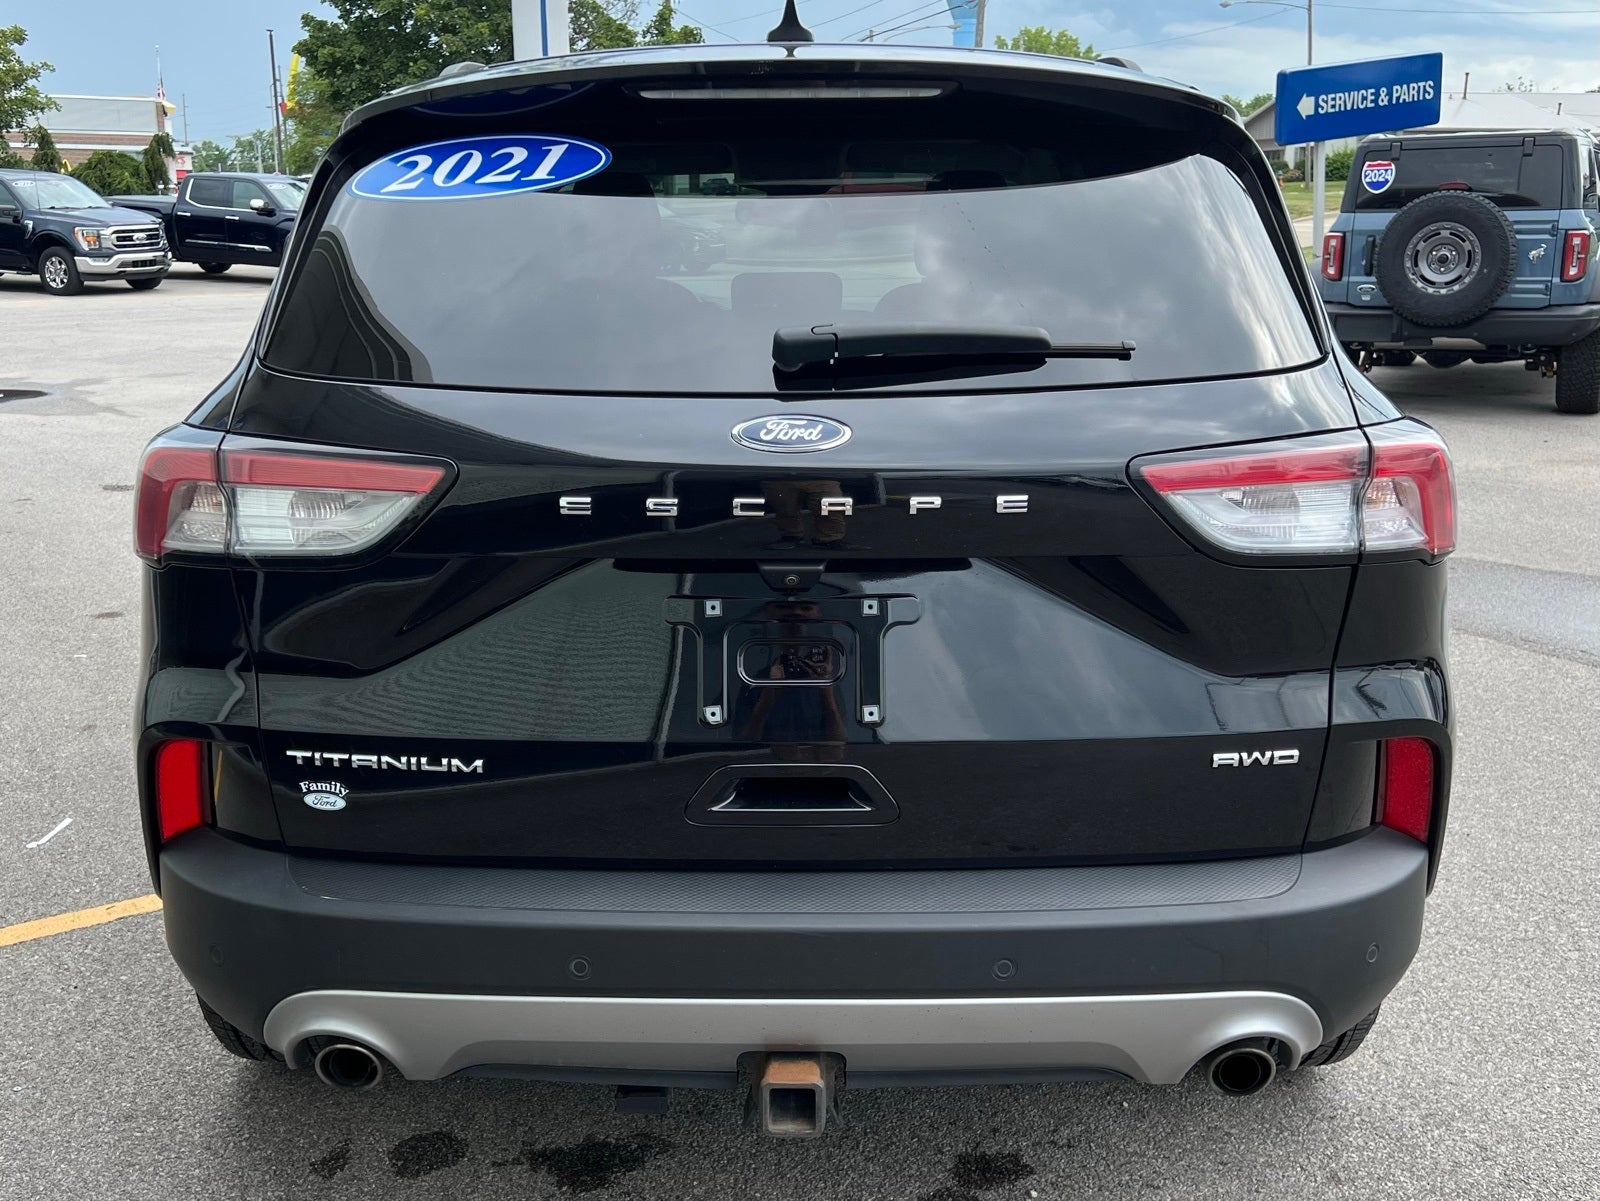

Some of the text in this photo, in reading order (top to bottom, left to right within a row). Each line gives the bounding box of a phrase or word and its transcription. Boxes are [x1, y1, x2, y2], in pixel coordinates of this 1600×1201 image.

[1318, 80, 1435, 115] SERVICE & PARTS
[380, 143, 570, 193] 2021
[1365, 169, 1392, 182] 2024
[759, 419, 824, 442] Ford
[559, 494, 1029, 517] ESCAPE
[285, 750, 485, 774] TITANIUM
[1212, 749, 1300, 768] AWD
[298, 781, 350, 797] Family
[312, 796, 338, 808] Ford
